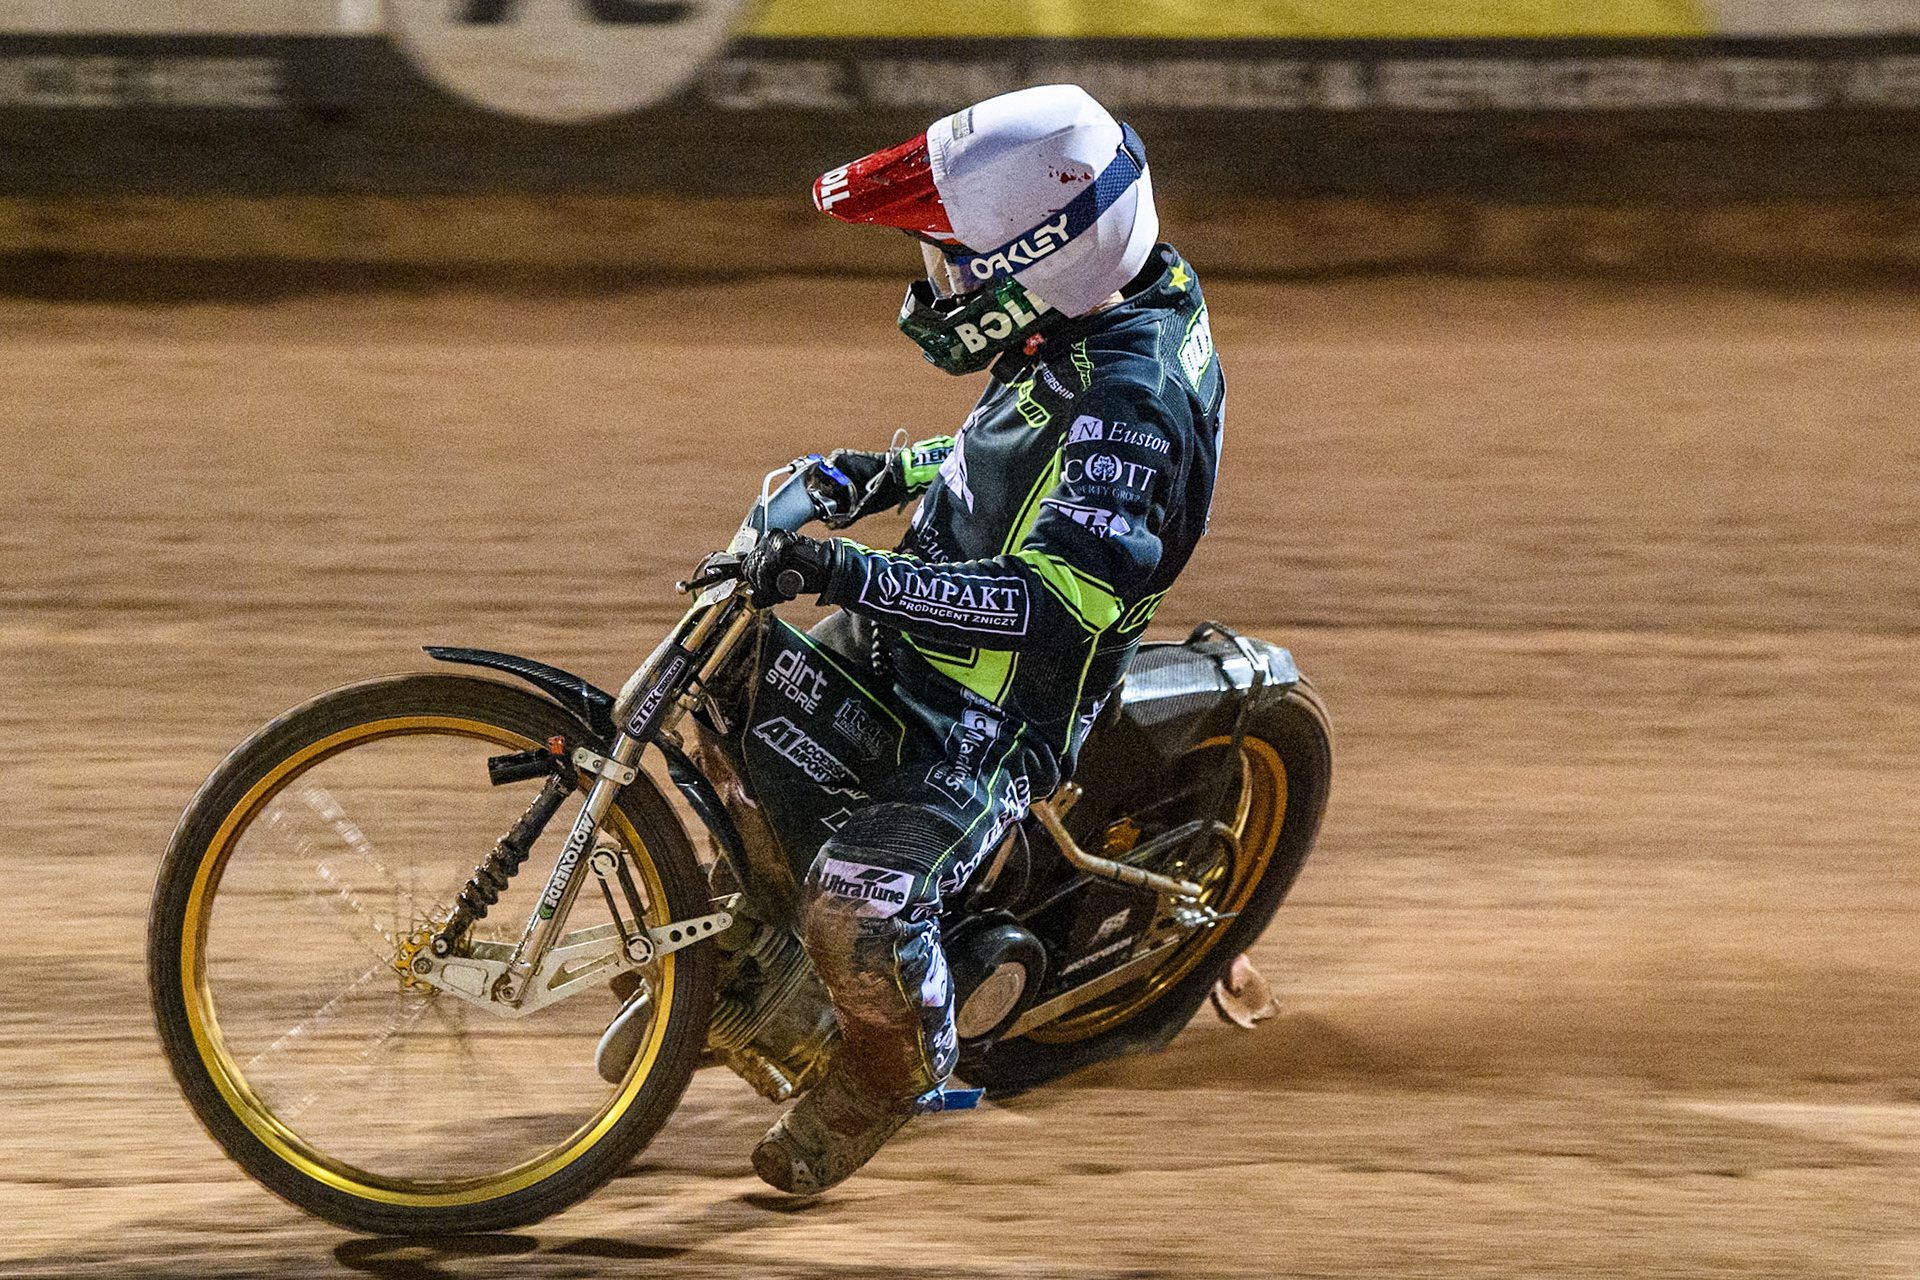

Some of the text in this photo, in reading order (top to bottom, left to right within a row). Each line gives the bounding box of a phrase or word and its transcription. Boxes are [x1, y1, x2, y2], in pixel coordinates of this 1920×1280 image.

[821, 166, 850, 211] OLL
[970, 213, 1069, 280] OAKLEY
[1108, 421, 1170, 454] Euston
[898, 599, 1017, 627] PRODUCENT ZNICZY
[904, 572, 1020, 612] IMPAKT
[765, 668, 819, 715] STORE
[773, 649, 828, 701] dirt
[630, 690, 662, 732] STEK
